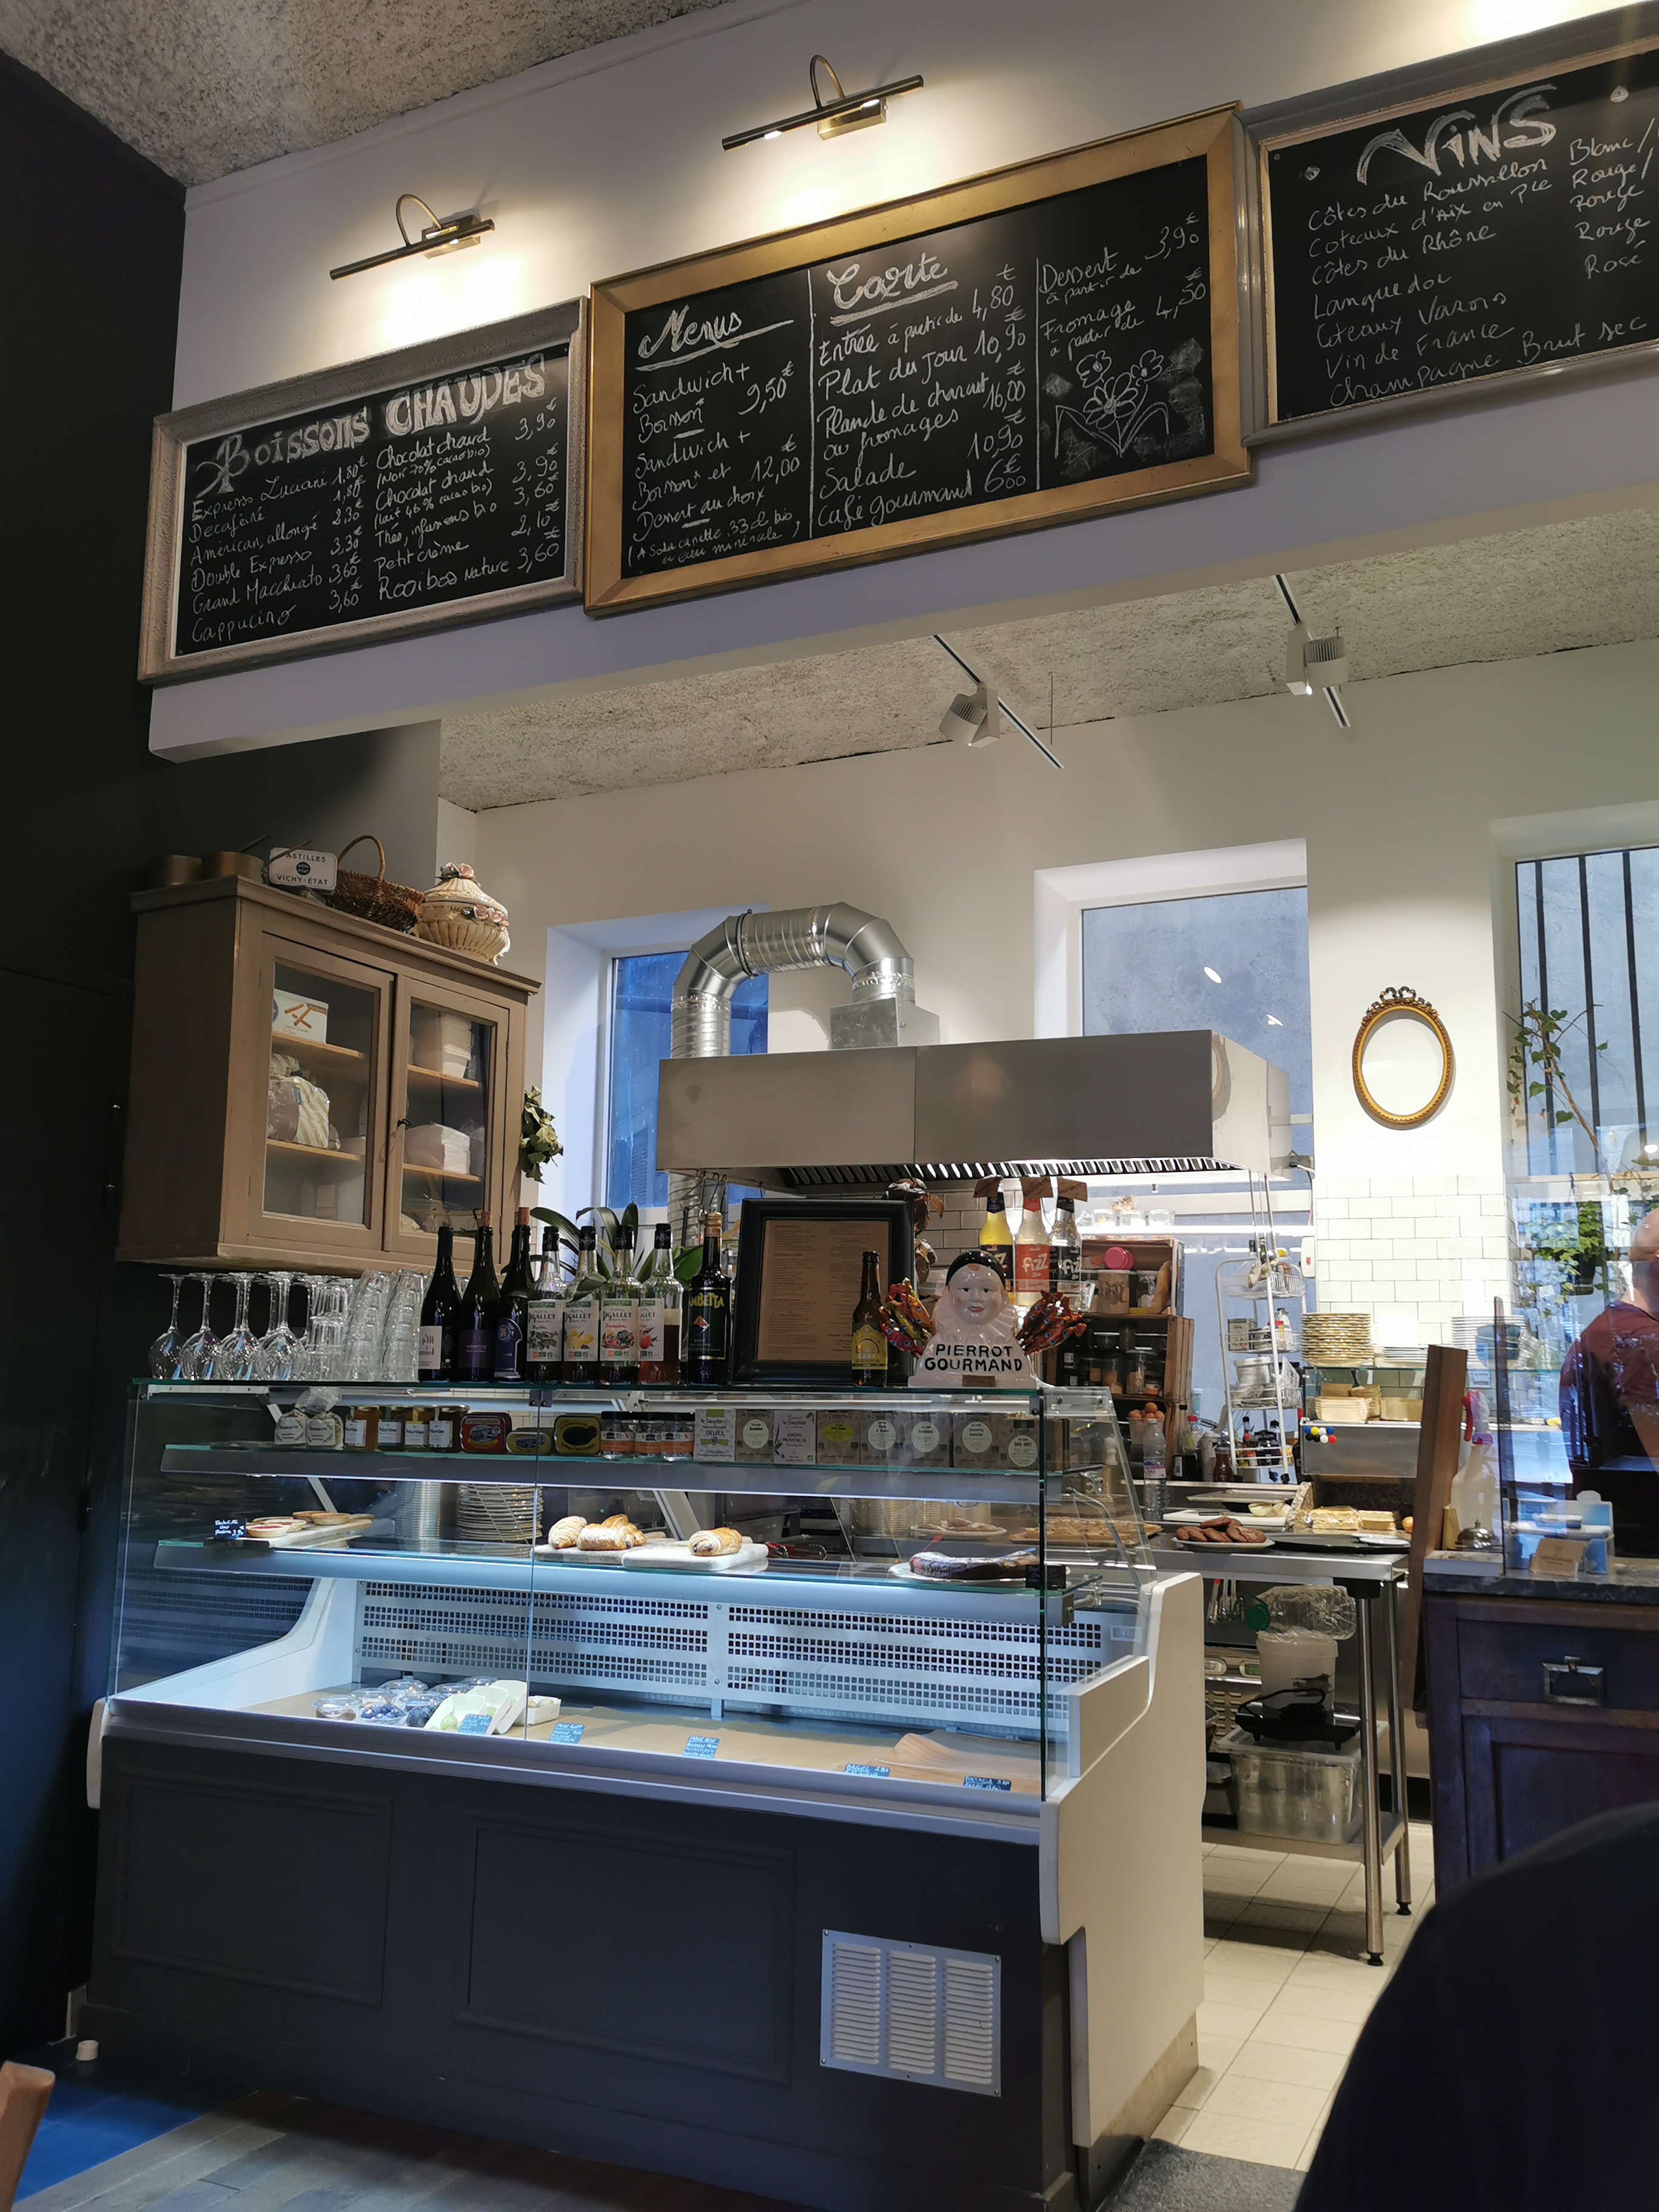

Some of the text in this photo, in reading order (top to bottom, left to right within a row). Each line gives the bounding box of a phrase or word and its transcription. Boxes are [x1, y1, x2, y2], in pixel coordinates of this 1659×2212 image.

[1309, 201, 1367, 230] Côtes
[1372, 194, 1408, 215] du
[1424, 159, 1548, 201] Roussillon
[1309, 223, 1399, 257] Coteaux
[1483, 199, 1503, 212] en
[1312, 186, 1645, 285] Côtes du Rhône Rouge
[826, 252, 948, 310] Carte
[1039, 247, 1118, 293] Dessert
[1064, 276, 1114, 306] partir
[1119, 263, 1142, 279] de
[1313, 218, 1651, 320] Languedoc Rouge
[1418, 292, 1507, 325] Varois
[1584, 240, 1646, 278] Rosé
[638, 304, 742, 358] Menus
[819, 324, 879, 367] Entrée
[905, 315, 942, 354] partir
[946, 306, 963, 324] de
[1040, 300, 1136, 340] Fromage
[1068, 324, 1111, 361] partir
[1121, 314, 1145, 332] de
[1326, 323, 1515, 378] Vin de France
[1330, 317, 1648, 407] Champagne Brut sec
[384, 353, 546, 436] CHAUDES
[632, 362, 734, 414] Sandwich
[818, 365, 881, 400] Plat
[889, 357, 917, 381] du
[891, 393, 920, 418] de
[376, 440, 435, 470] Chocolat
[436, 426, 491, 455] chaud
[635, 431, 729, 479] Sandwich
[857, 409, 959, 469] fromages
[376, 478, 437, 511] Chocolat
[441, 460, 494, 489] chaud
[707, 462, 731, 481] et
[820, 452, 917, 499] Salade
[191, 495, 253, 522] Expresso
[261, 471, 327, 501] Luciani
[405, 503, 421, 519] 46
[439, 489, 468, 504] cacao
[474, 500, 497, 518] bio
[632, 485, 766, 541] Dessert au choix
[818, 494, 863, 531] Café
[870, 469, 973, 528] gourmand
[267, 512, 320, 541] allongé
[649, 541, 676, 557] Soda
[678, 528, 722, 548] canette
[677, 546, 706, 563] eau
[712, 527, 783, 555] minérale
[191, 562, 241, 592] Double
[249, 550, 313, 574] Expresso
[374, 549, 414, 578] Petit
[417, 540, 470, 563] crème
[193, 587, 241, 615] Grand
[246, 563, 323, 605] Macchiato
[378, 568, 458, 601] Rooibos
[192, 604, 297, 643] Cappucino
[286, 853, 326, 863] ASTILLES
[924, 1357, 1022, 1372] GOURMAND
[936, 1344, 1013, 1358] PIERROT
